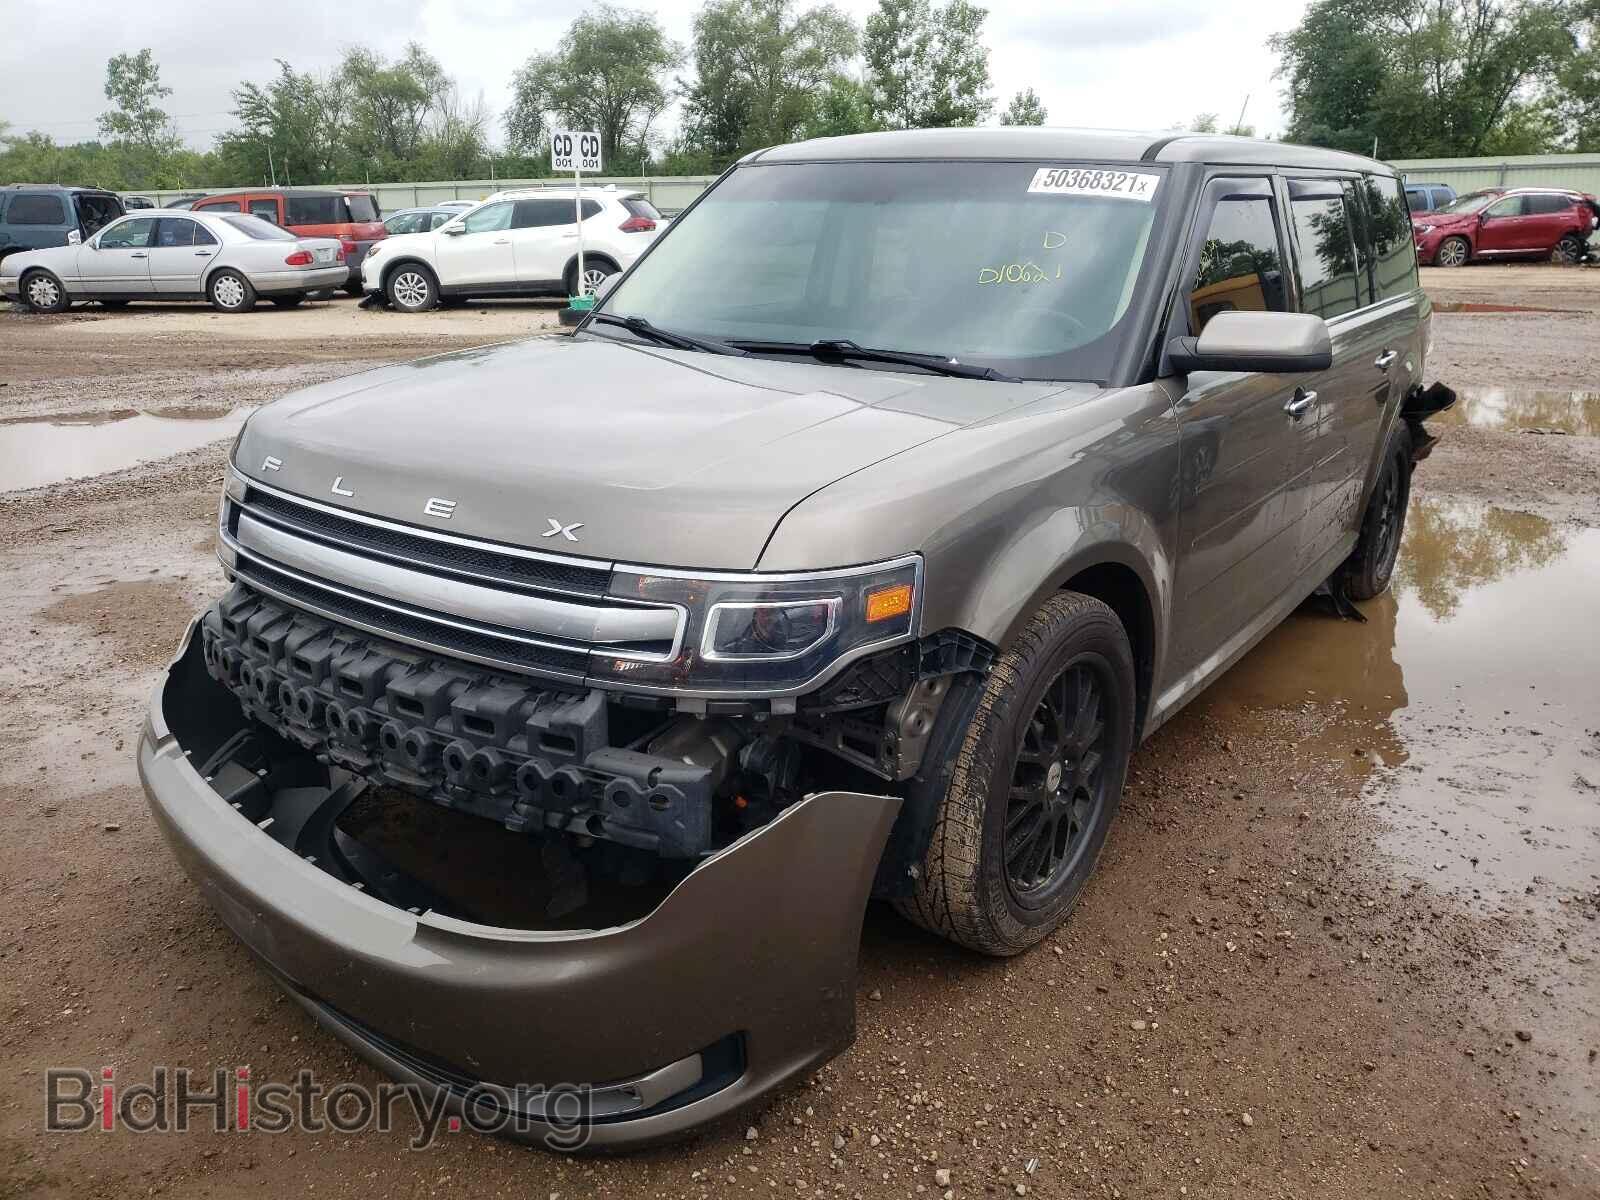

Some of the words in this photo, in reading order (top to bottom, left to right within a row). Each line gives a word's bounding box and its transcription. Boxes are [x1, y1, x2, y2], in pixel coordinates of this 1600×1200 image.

[553, 134, 573, 157] CD
[580, 135, 599, 158] CD
[555, 158, 572, 168] 001
[582, 159, 599, 168] 001
